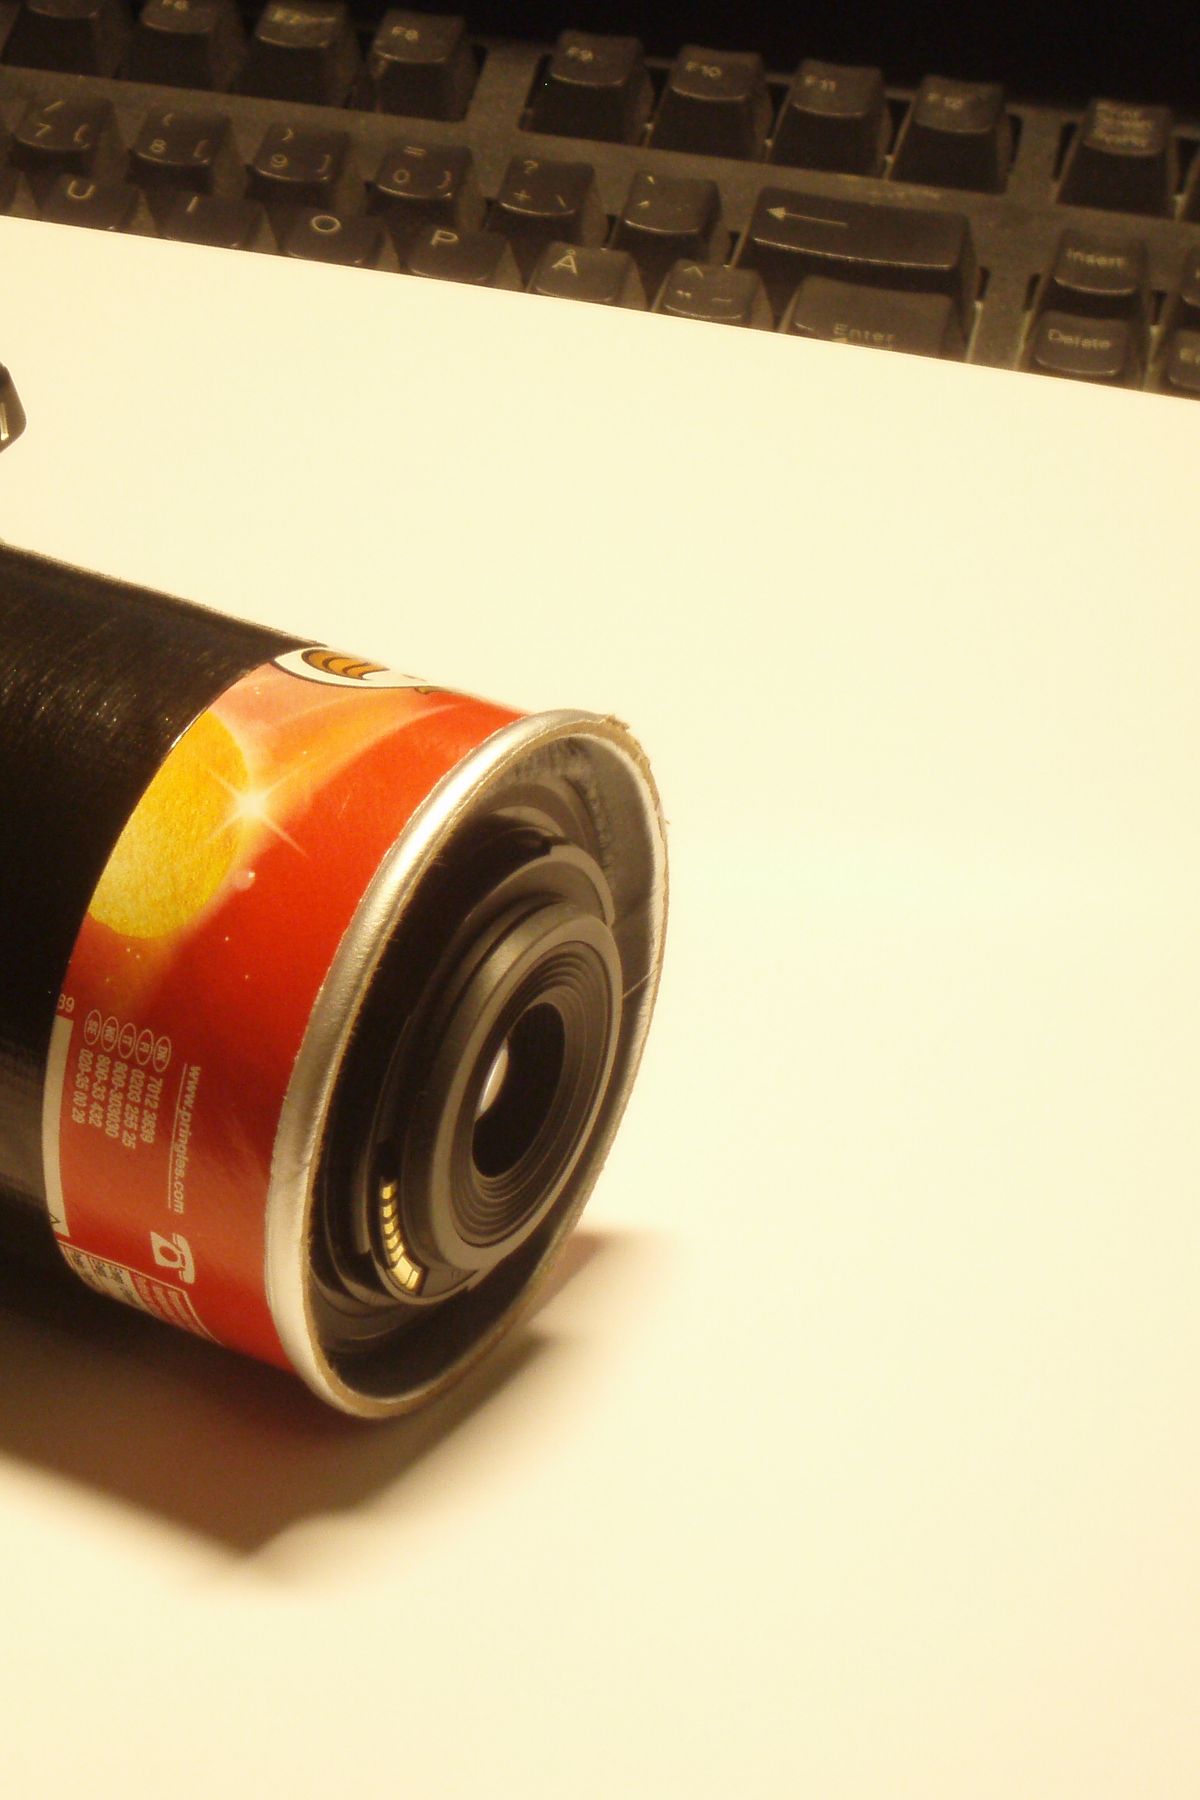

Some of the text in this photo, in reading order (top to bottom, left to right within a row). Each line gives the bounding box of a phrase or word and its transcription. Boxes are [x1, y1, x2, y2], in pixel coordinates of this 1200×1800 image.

[66, 179, 97, 201] U
[310, 214, 341, 234] O
[430, 228, 460, 247] P
[551, 249, 579, 275] Å
[144, 1076, 164, 1110] 7012
[172, 1065, 201, 1216] www.pringles.com
